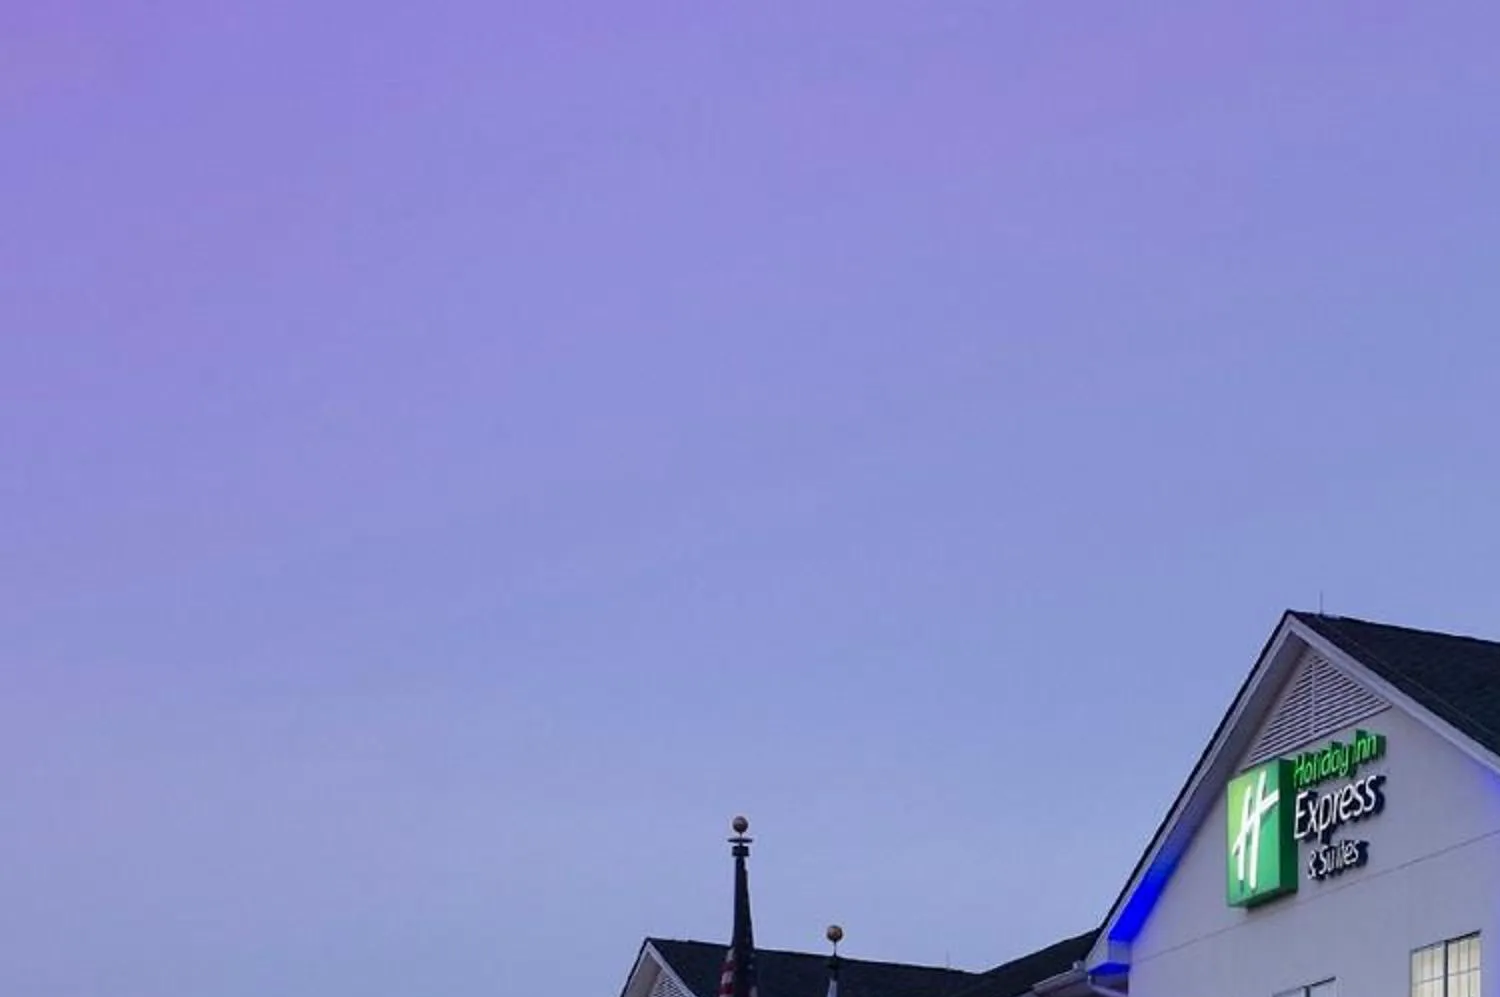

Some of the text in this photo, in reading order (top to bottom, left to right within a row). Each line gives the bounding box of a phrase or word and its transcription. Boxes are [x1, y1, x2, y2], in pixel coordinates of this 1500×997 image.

[1293, 732, 1379, 788] Holiday Inn
[1293, 774, 1378, 845] Express
